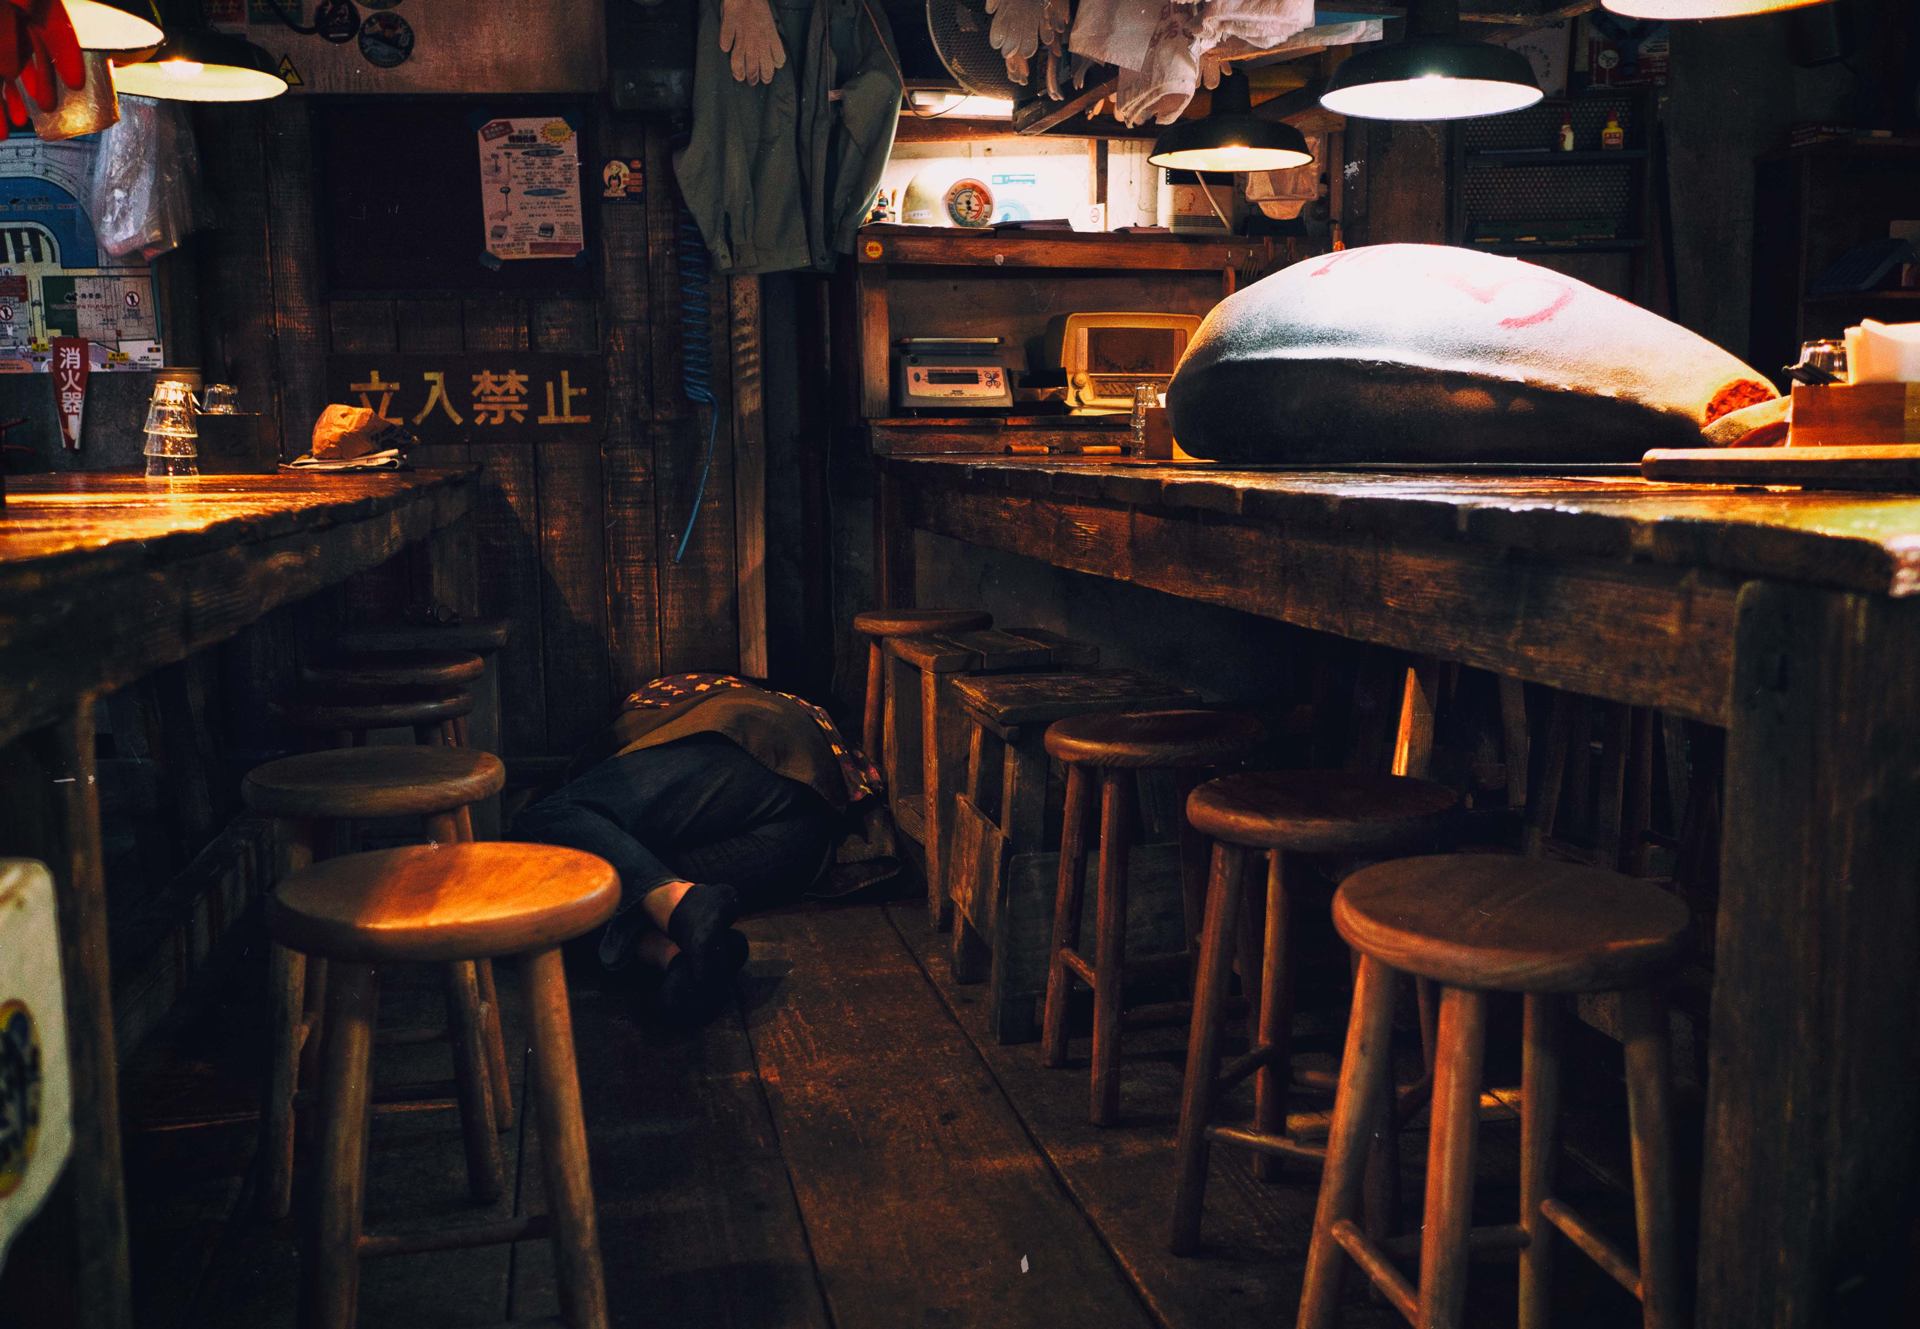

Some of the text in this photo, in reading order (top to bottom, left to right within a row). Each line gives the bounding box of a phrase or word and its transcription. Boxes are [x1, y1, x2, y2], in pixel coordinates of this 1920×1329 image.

[59, 346, 84, 414] 消火器
[350, 369, 592, 426] 立入禁止
